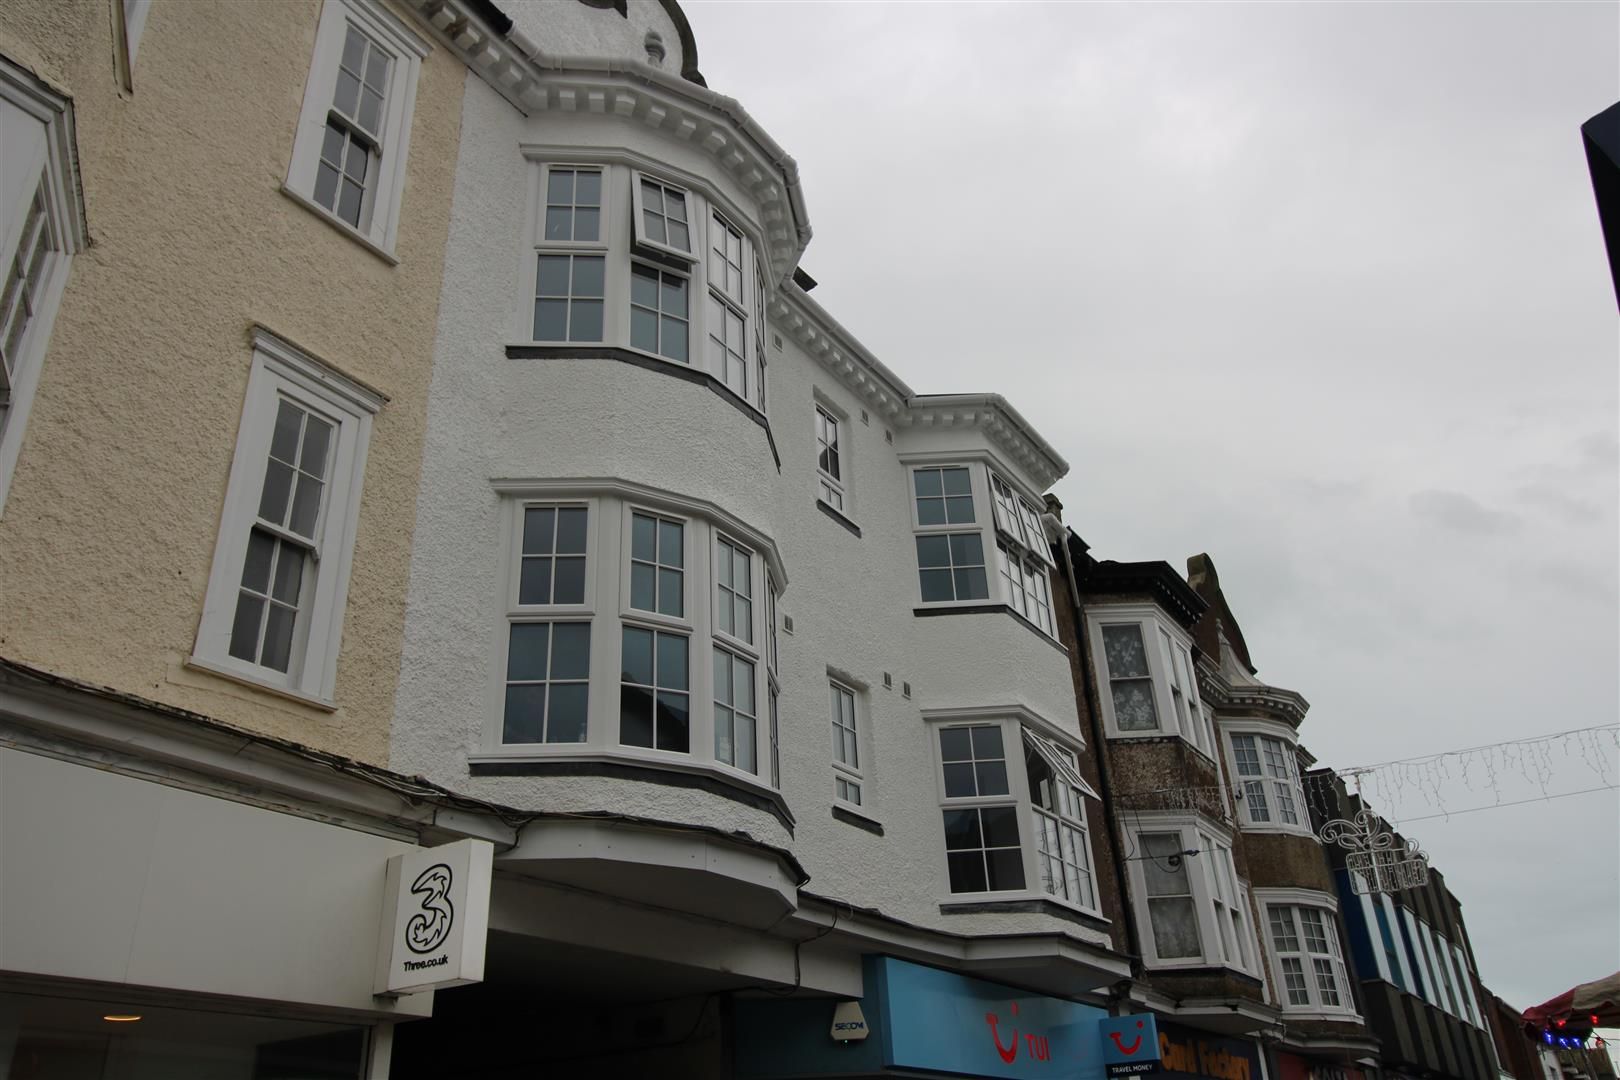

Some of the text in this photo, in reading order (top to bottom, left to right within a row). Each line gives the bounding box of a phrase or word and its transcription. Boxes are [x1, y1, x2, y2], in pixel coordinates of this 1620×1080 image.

[404, 954, 448, 971] Three.co.uk
[835, 1021, 864, 1031] SECOM
[1024, 1034, 1050, 1062] TUI
[1111, 1064, 1153, 1074] TRAVEL MONEY
